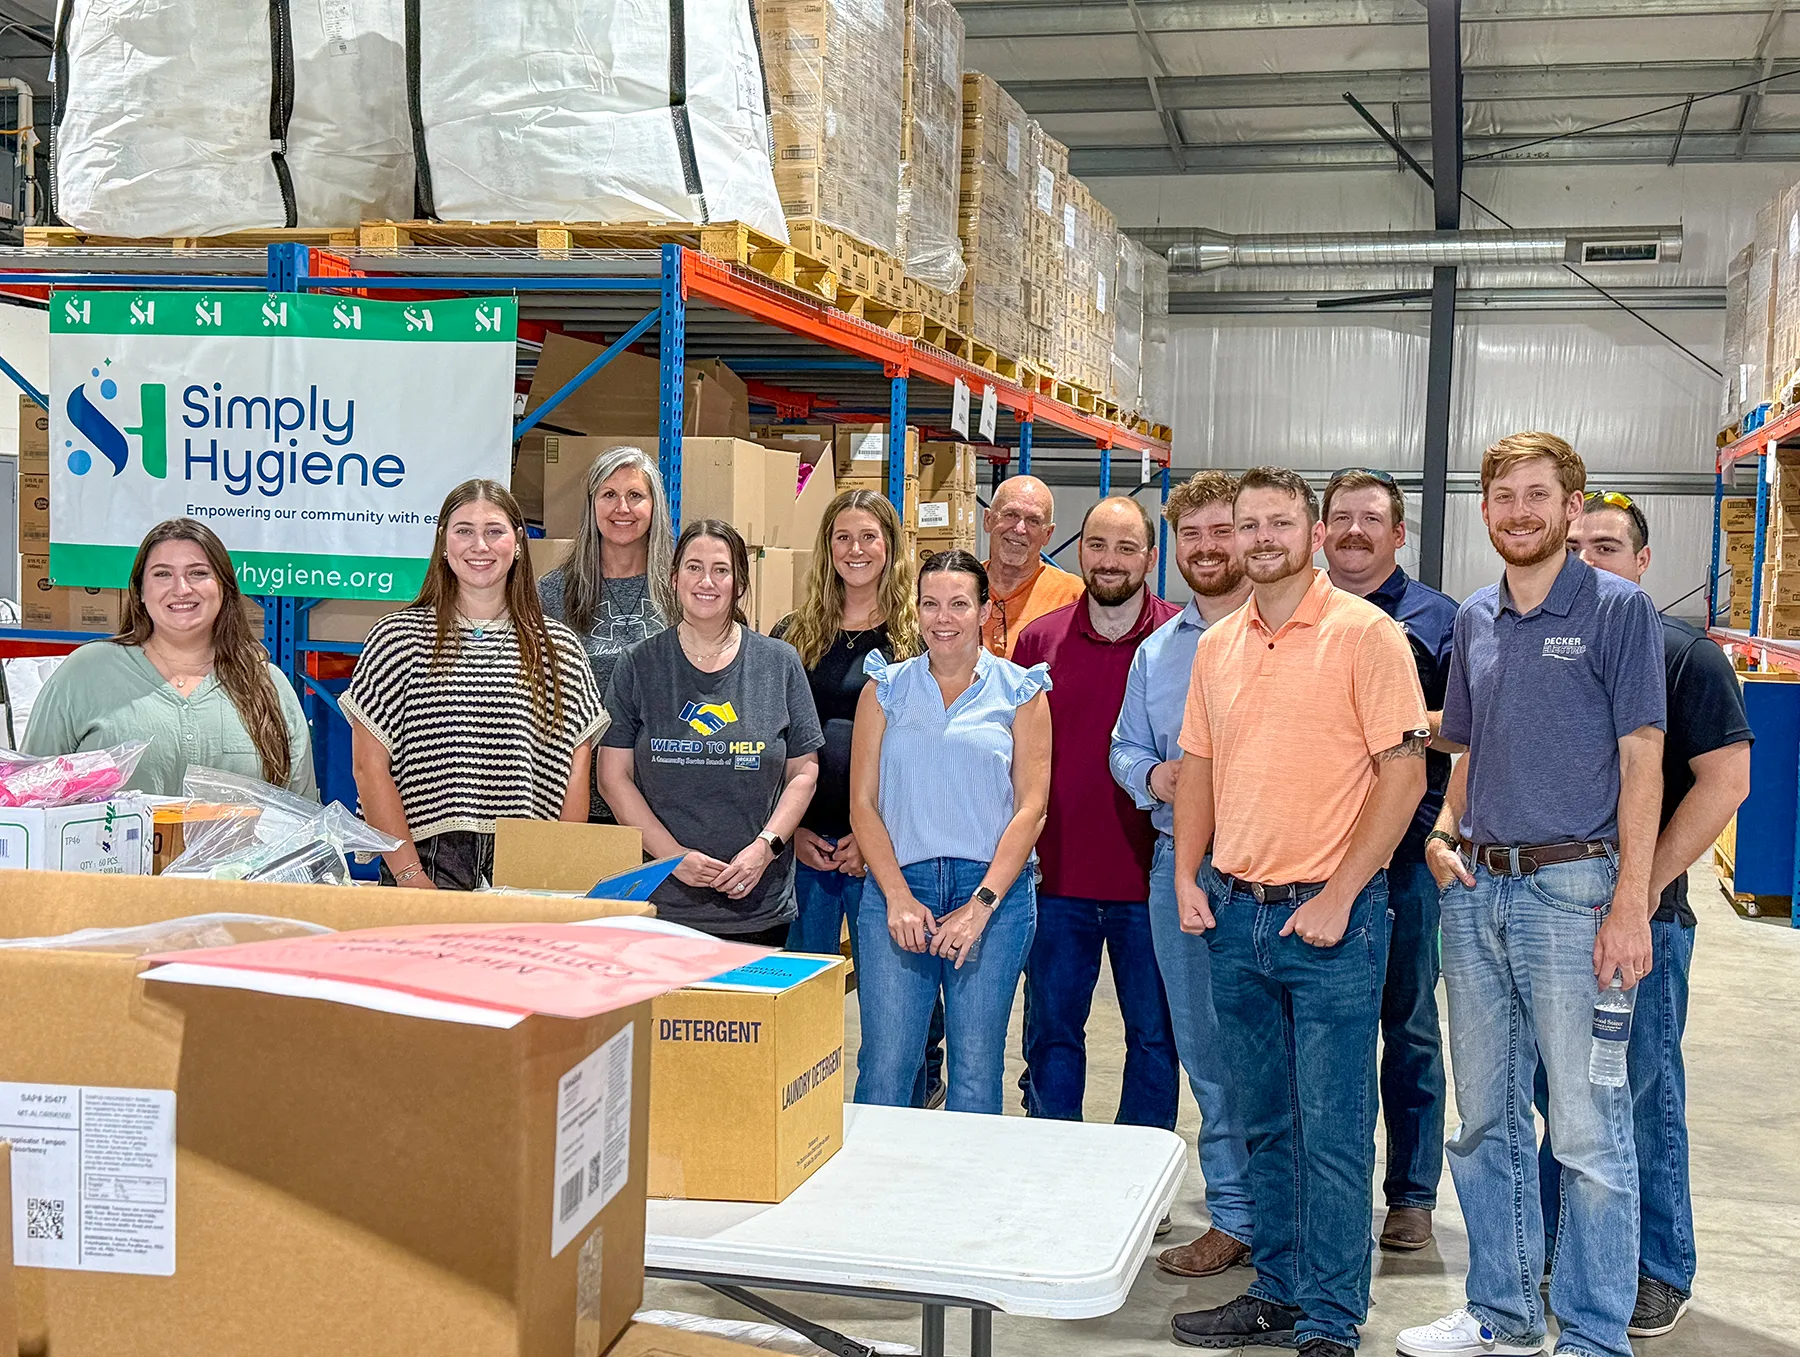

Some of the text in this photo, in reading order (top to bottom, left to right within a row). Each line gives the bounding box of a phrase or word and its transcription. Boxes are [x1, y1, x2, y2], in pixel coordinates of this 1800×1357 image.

[181, 382, 355, 445] Simply
[184, 438, 406, 497] Hygiene
[186, 504, 271, 520] Empowering
[274, 509, 297, 519] our
[301, 510, 384, 525] community
[388, 511, 419, 524] with
[1544, 637, 1581, 645] DECKER
[650, 738, 766, 754] WIRED TO HELP
[656, 756, 685, 765] Community
[65, 836, 81, 846] TP46
[659, 1019, 762, 1044] DETERGENT
[782, 1045, 842, 1111] LAUNDRY DETERGENT
